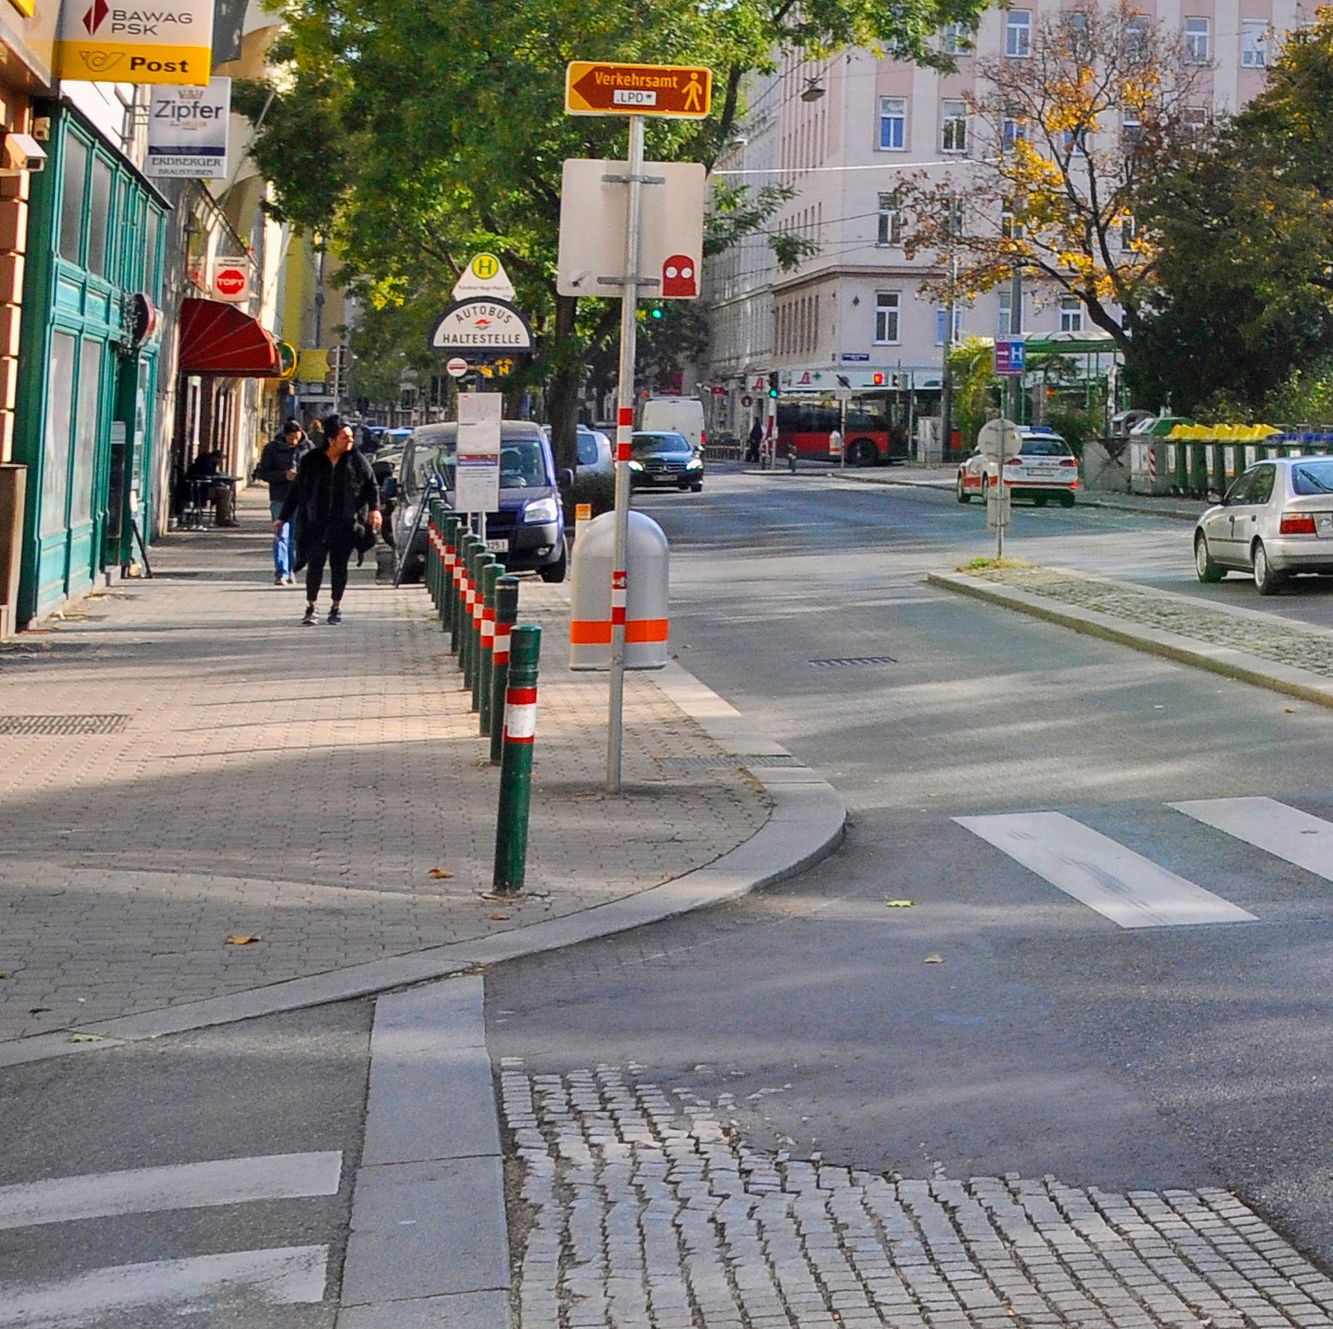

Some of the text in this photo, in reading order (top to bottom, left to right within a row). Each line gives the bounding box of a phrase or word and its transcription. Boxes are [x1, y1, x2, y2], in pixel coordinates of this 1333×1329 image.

[112, 9, 193, 24] BAWAG
[111, 22, 158, 36] PSK
[130, 56, 190, 73] Post
[595, 72, 678, 88] Verkehrsamt
[154, 100, 223, 122] Zipfer
[151, 157, 221, 167] ERDBERGER
[479, 259, 492, 275] H
[217, 278, 244, 287] TOPY
[455, 305, 512, 324] AUTOBUS
[443, 333, 520, 344] HALTESTELLE
